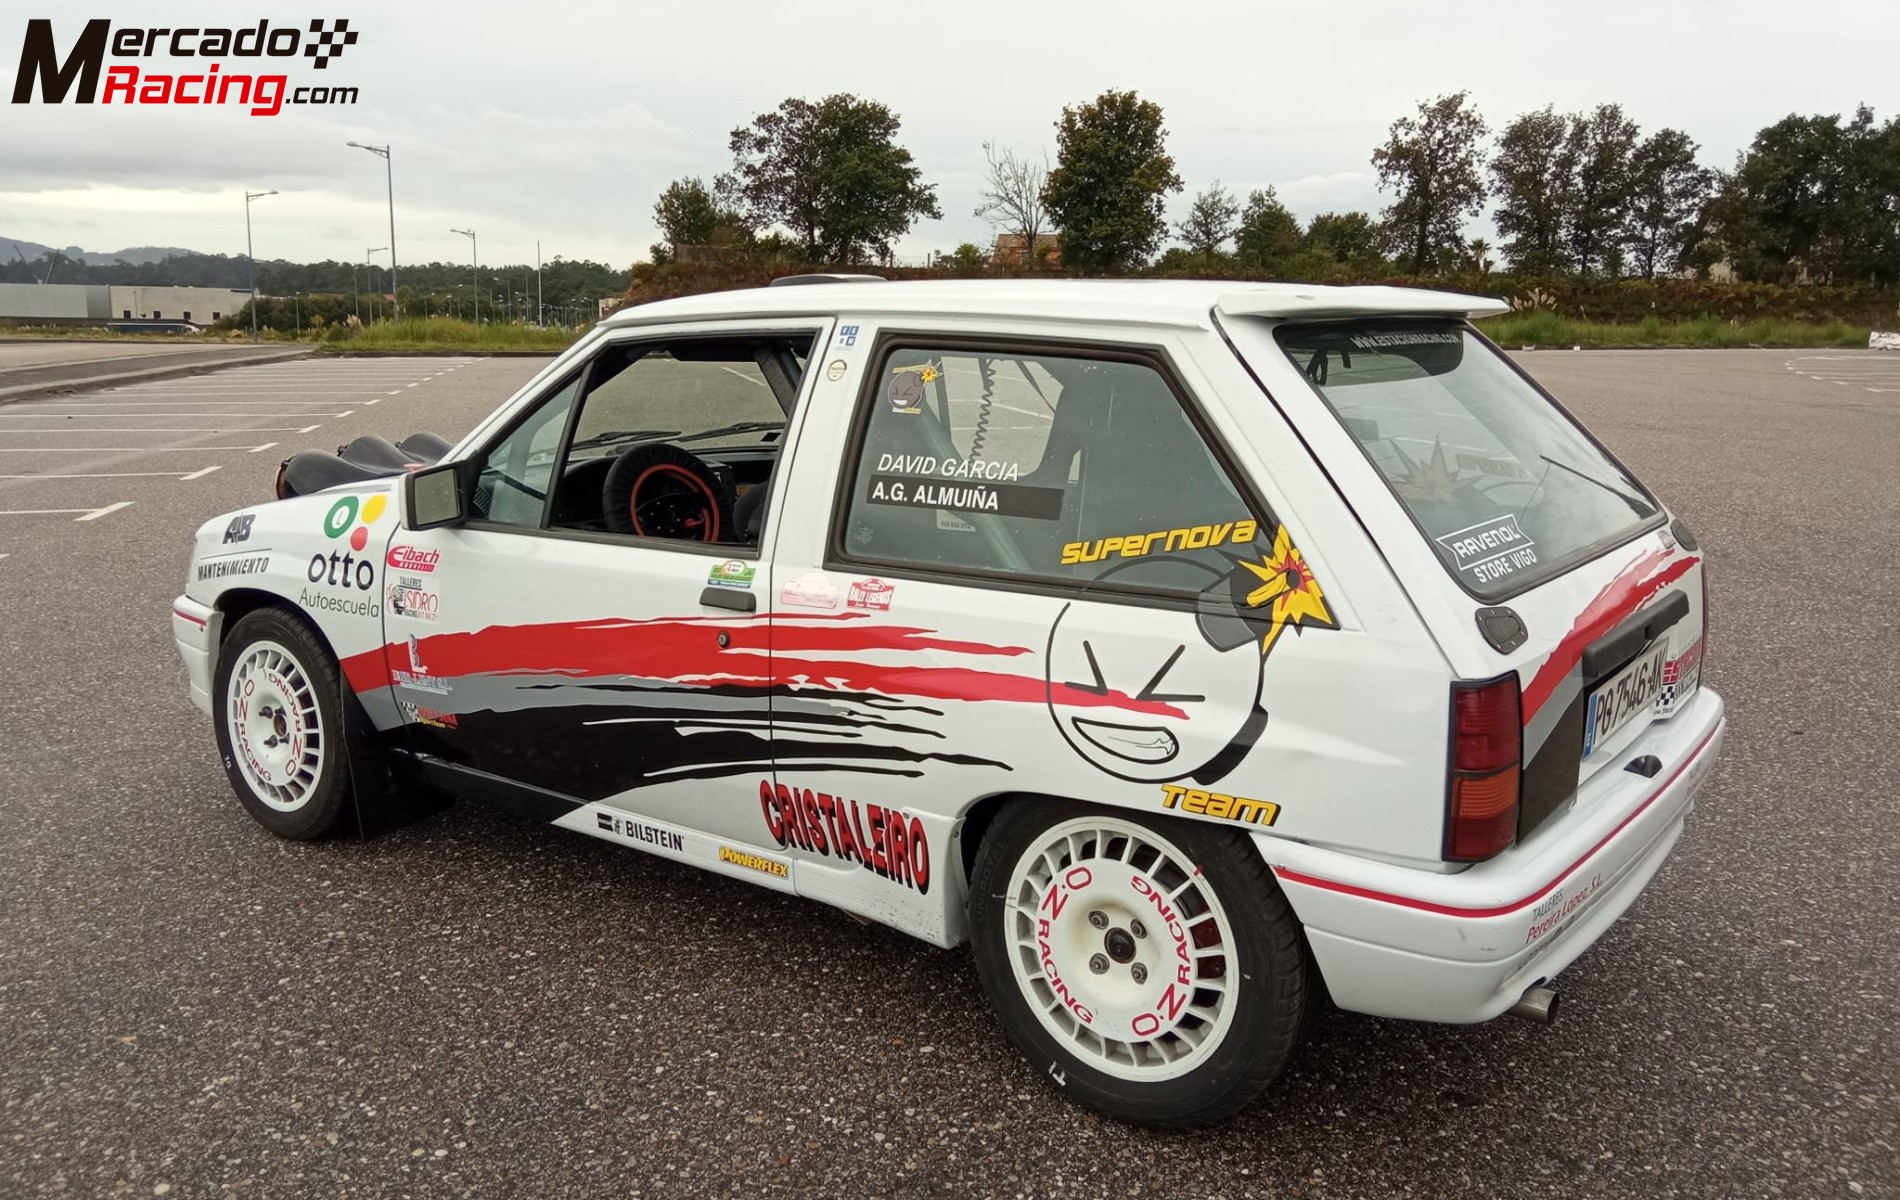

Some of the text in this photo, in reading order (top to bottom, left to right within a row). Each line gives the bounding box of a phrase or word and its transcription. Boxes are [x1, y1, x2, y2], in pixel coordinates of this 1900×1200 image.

[877, 452, 1020, 482] DAVID GARCIA
[872, 480, 1000, 511] A.G. ALMUIÑA
[1452, 525, 1520, 558] RAVENOL
[197, 557, 270, 581] MANTENIMIENTO
[307, 551, 374, 591] otto
[387, 545, 440, 573] Eibach
[1473, 548, 1537, 583] STORE VIGO
[399, 576, 422, 589] TALLERES
[298, 587, 380, 619] Autoescuela
[268, 673, 302, 733] RACING
[239, 723, 272, 782] RACING
[625, 820, 683, 852] BILSTEIN
[759, 779, 930, 895] CRISTALEIRO
[719, 845, 788, 877] POWERFLEX
[975, 838, 1008, 924] UNIROYAL
[1532, 888, 1563, 922] TALLERES
[1130, 875, 1191, 986] RACING
[1525, 909, 1561, 944] Pereira
[1037, 918, 1094, 1025] RACING
